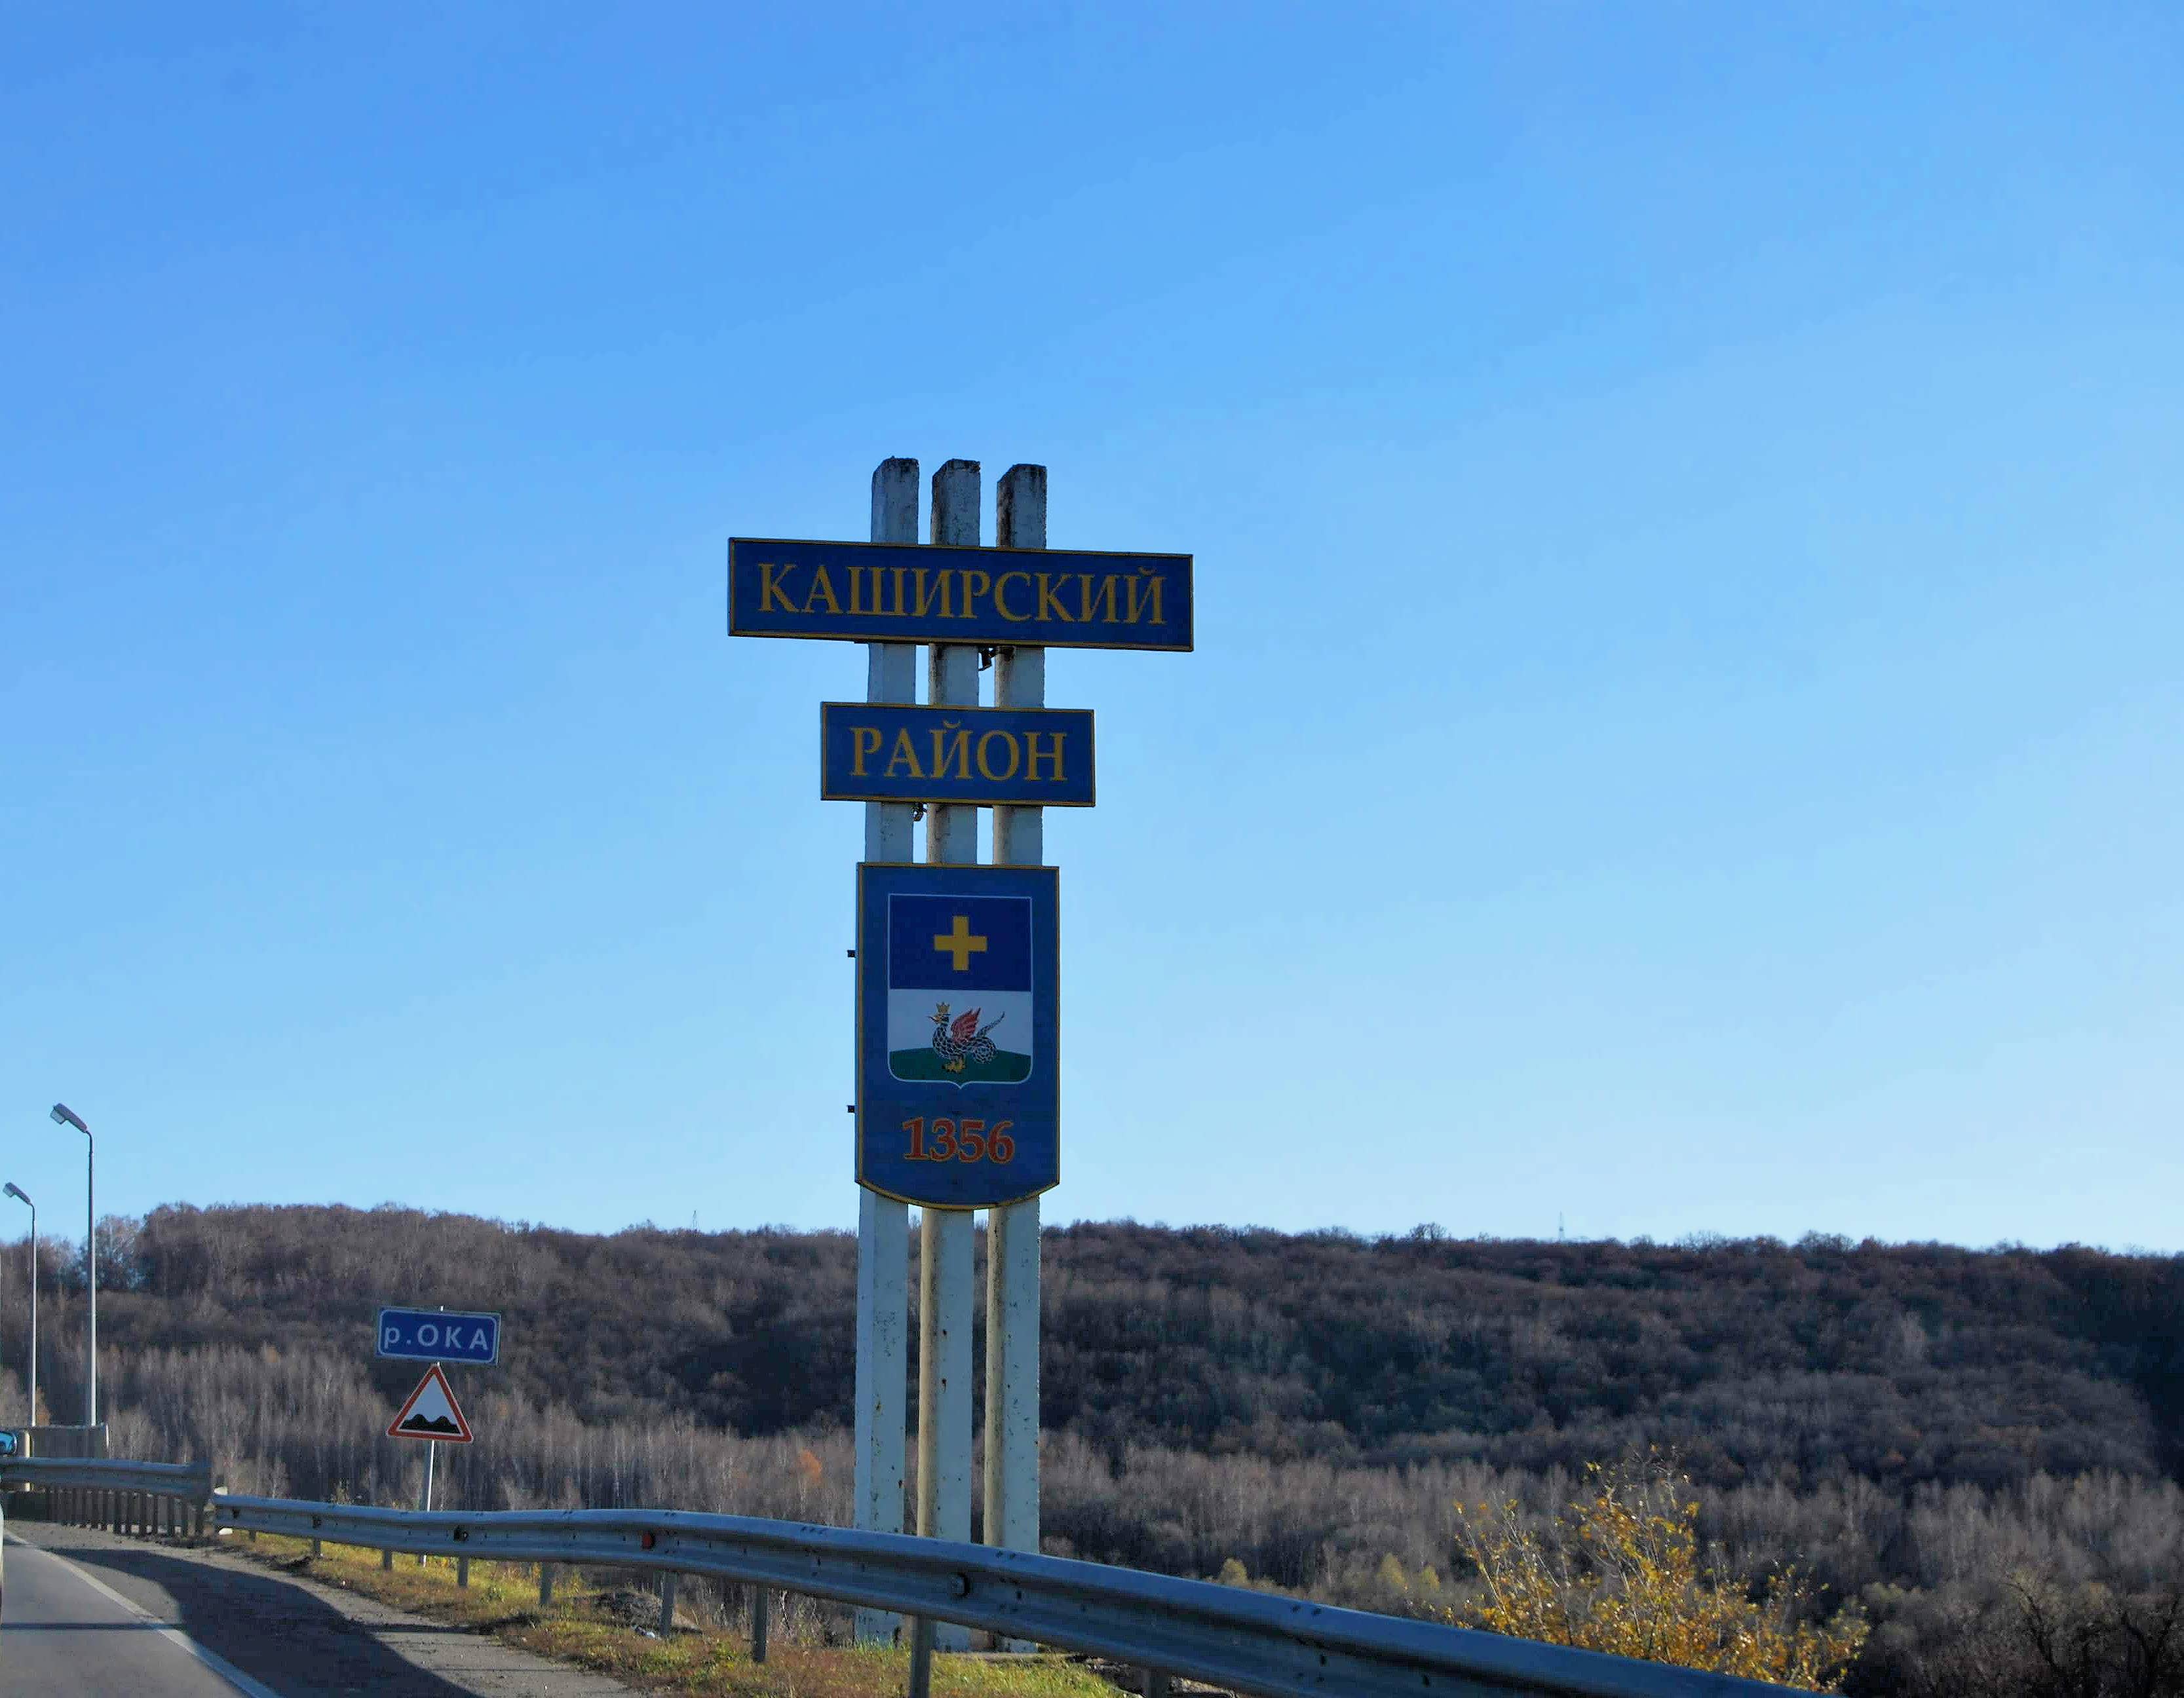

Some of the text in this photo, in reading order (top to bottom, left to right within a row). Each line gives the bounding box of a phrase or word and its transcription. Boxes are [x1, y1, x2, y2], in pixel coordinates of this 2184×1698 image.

[757, 562, 1166, 626] КАШИРСКИЙ
[849, 720, 1069, 783] РАЙОН
[902, 1116, 1016, 1164] 1356
